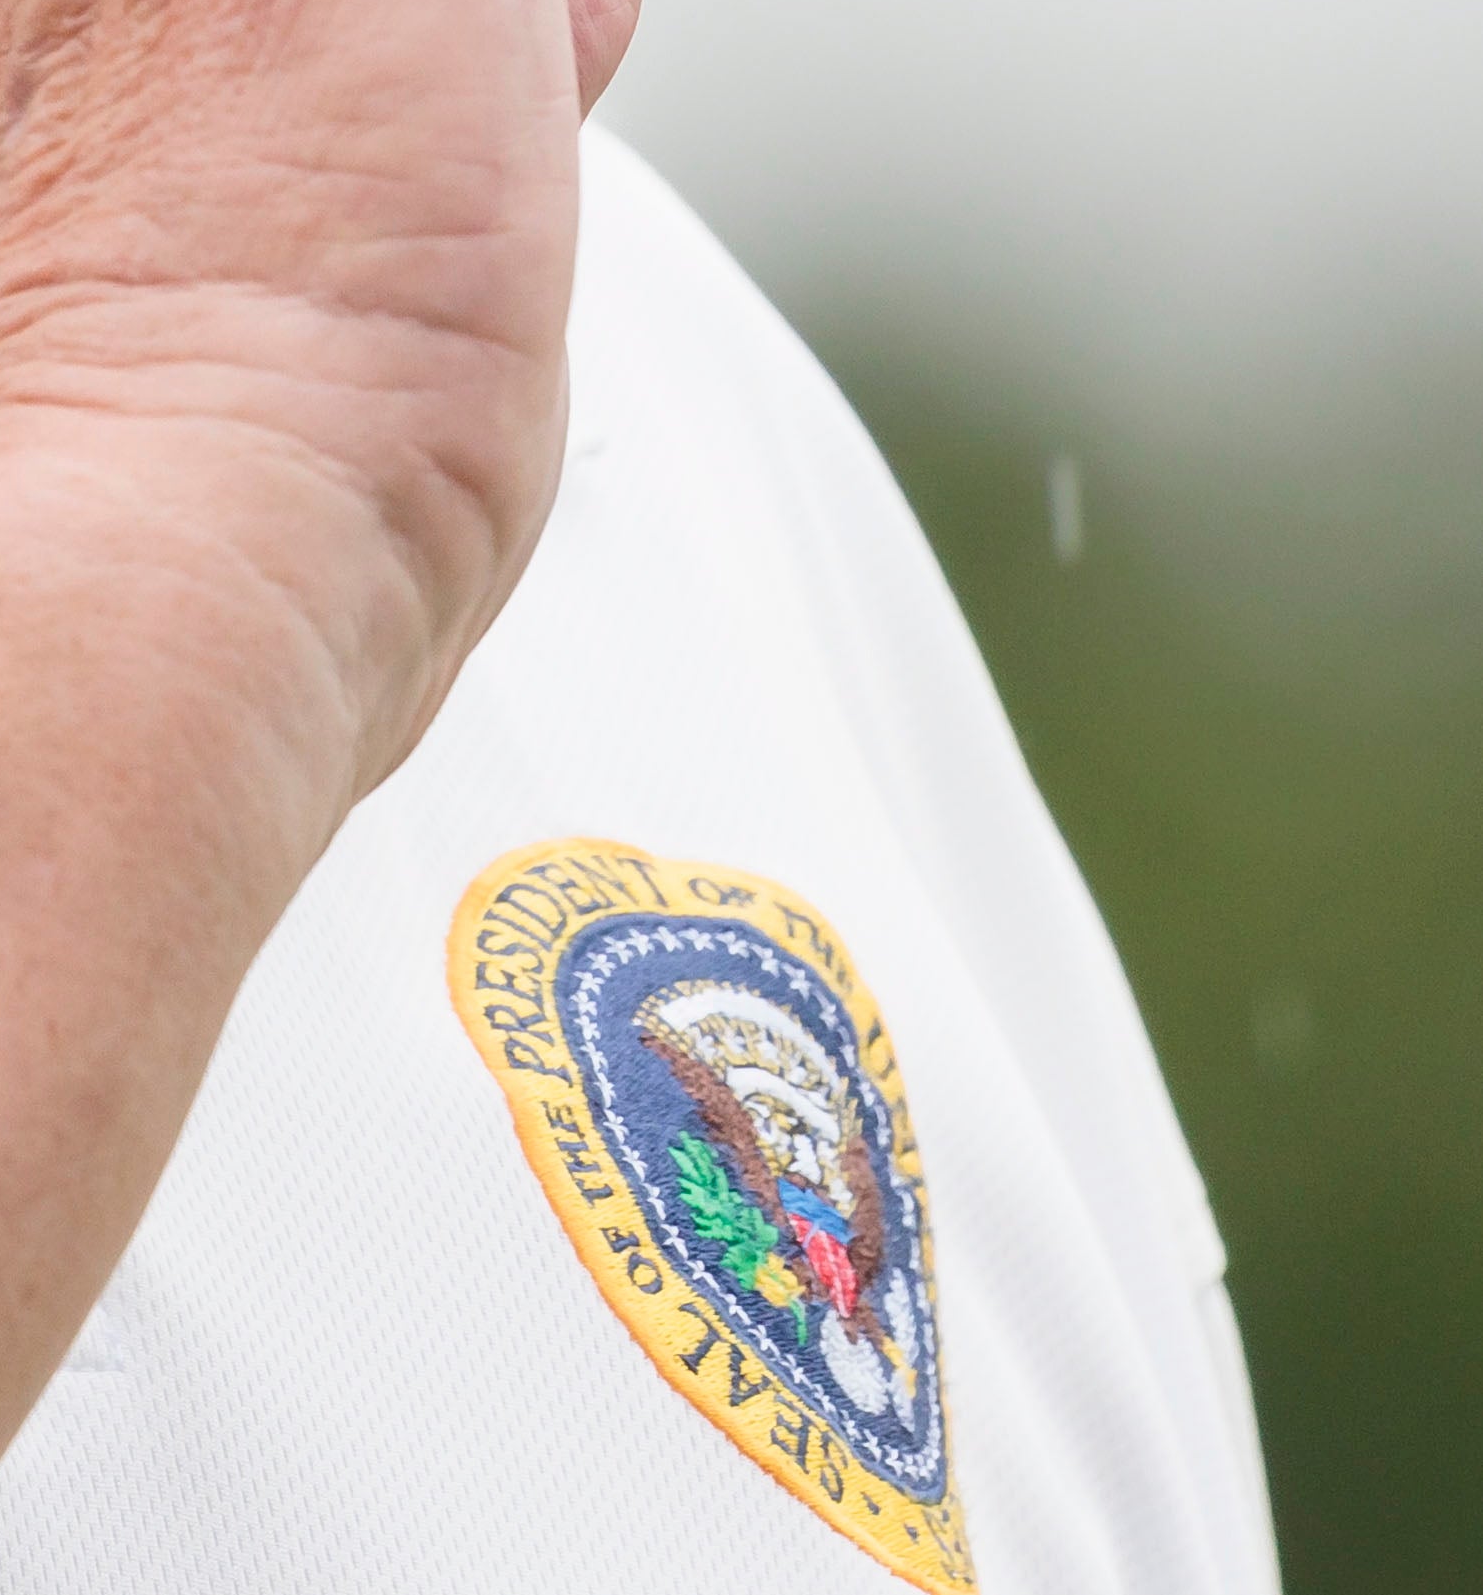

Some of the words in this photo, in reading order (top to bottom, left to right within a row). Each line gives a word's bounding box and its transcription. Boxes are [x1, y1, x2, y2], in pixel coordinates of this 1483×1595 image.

[475, 855, 669, 1088] PRESIDENT
[541, 1101, 615, 1208] THE
[600, 1226, 665, 1295] OF
[678, 1303, 849, 1501] SEAL
